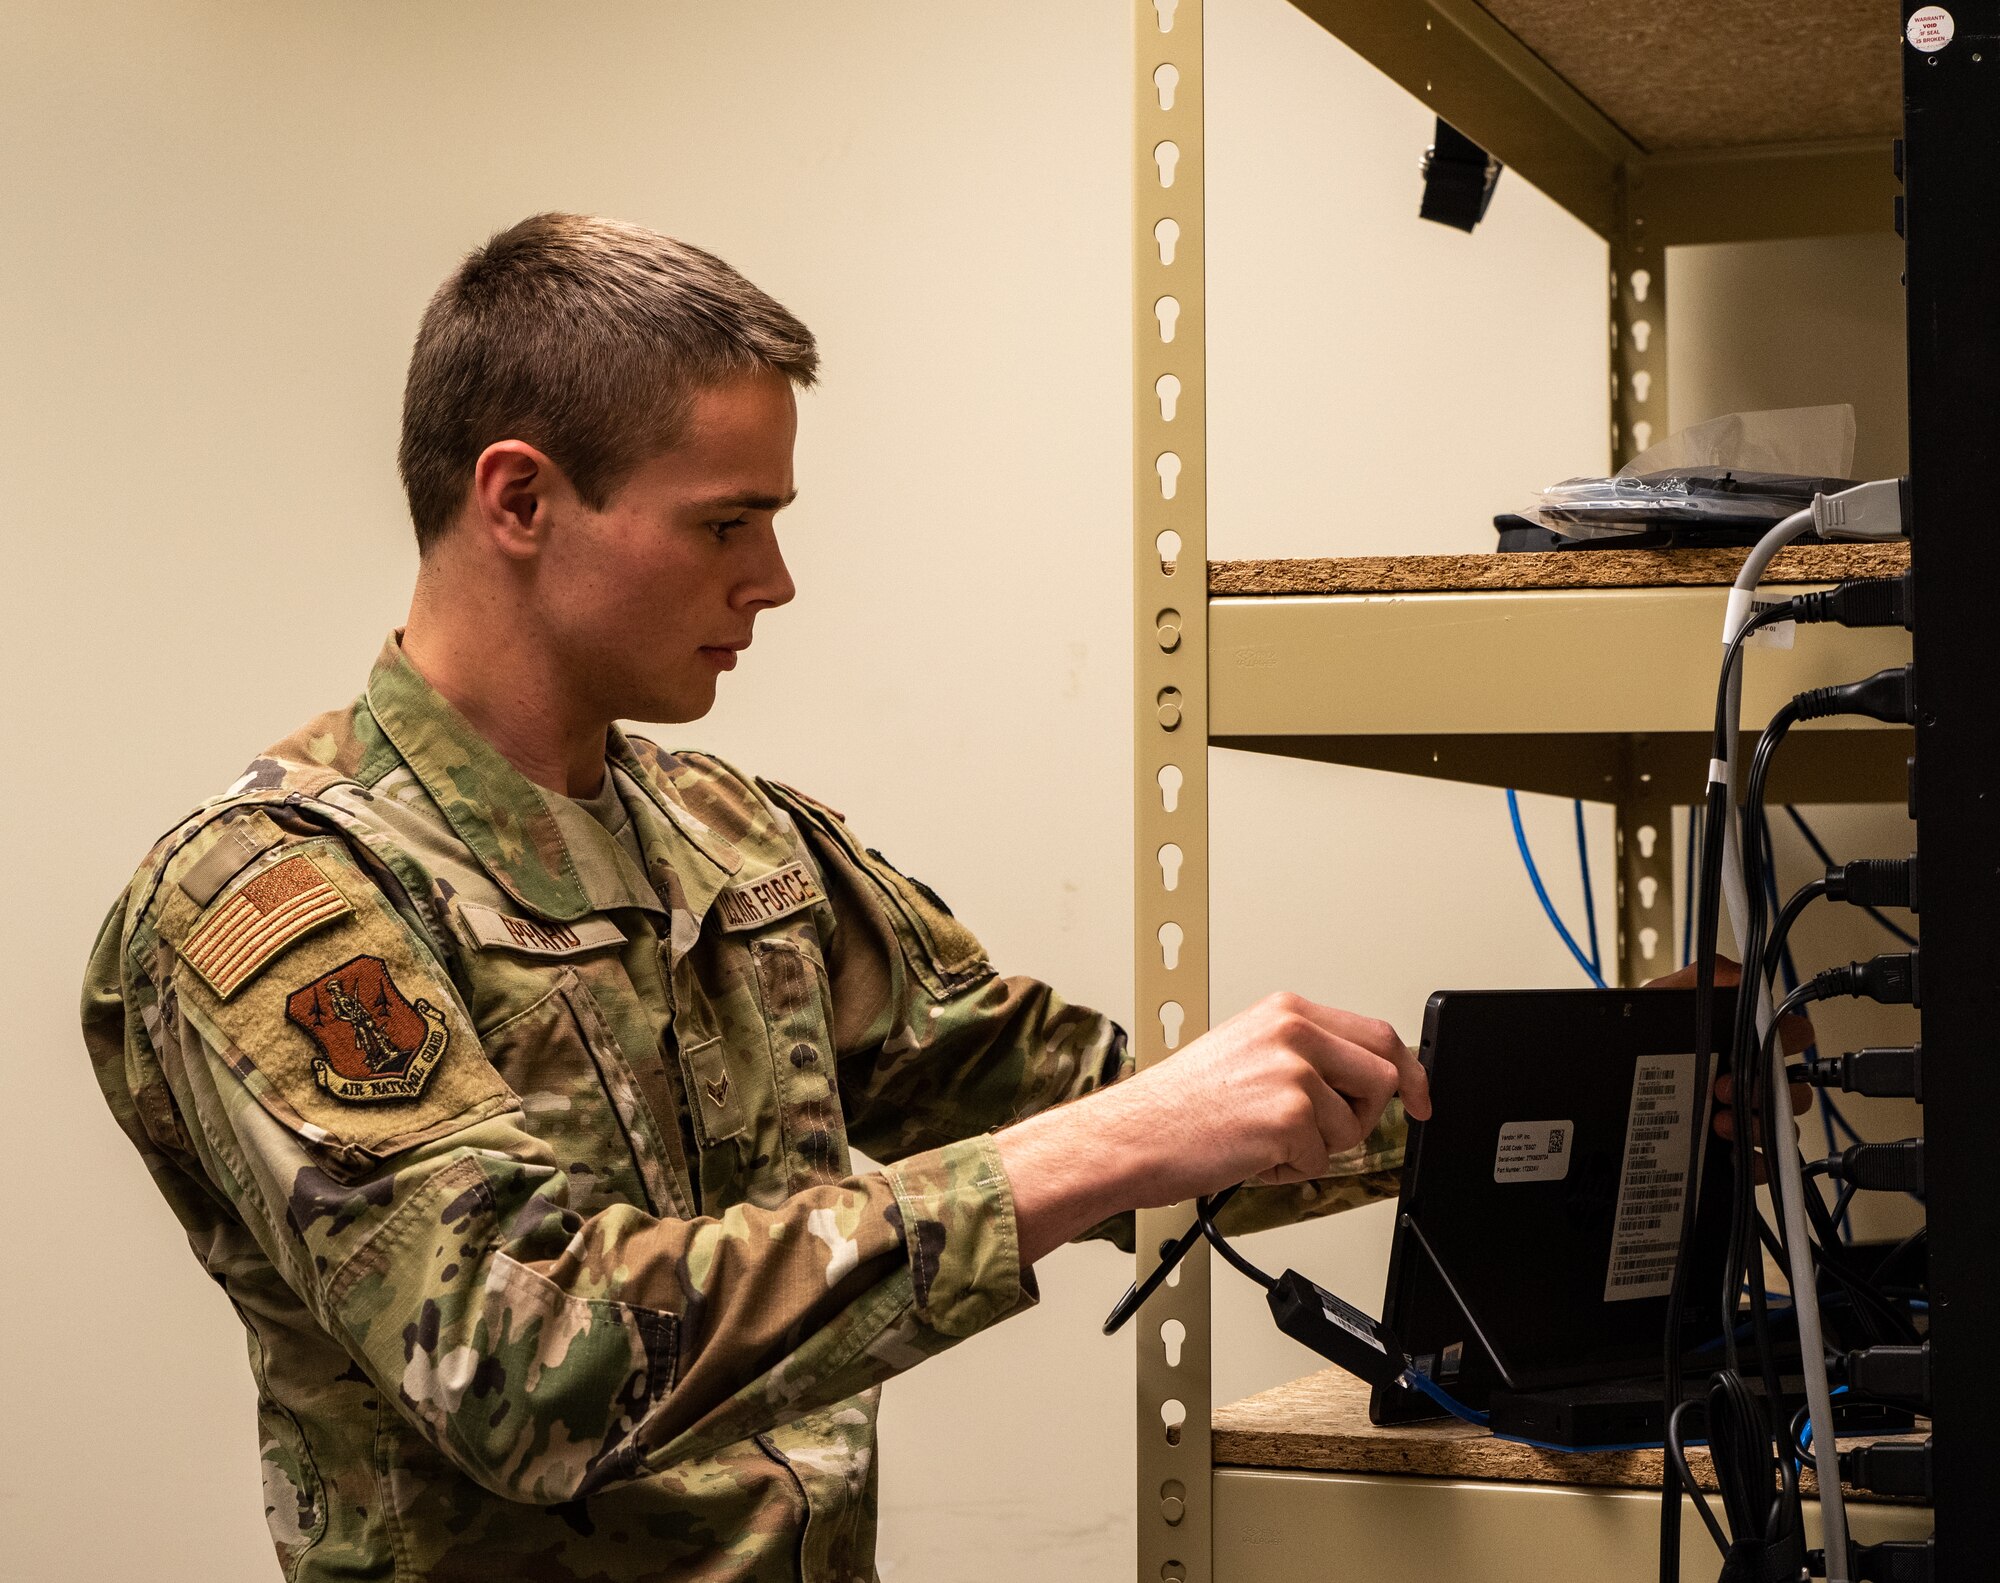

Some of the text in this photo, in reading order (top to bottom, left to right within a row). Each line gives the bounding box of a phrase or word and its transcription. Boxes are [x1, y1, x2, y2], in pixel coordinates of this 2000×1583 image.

[731, 890, 763, 923] AIR
[751, 869, 816, 916] FORCE
[339, 1031, 444, 1095] AIR NATIONAL GUARD
